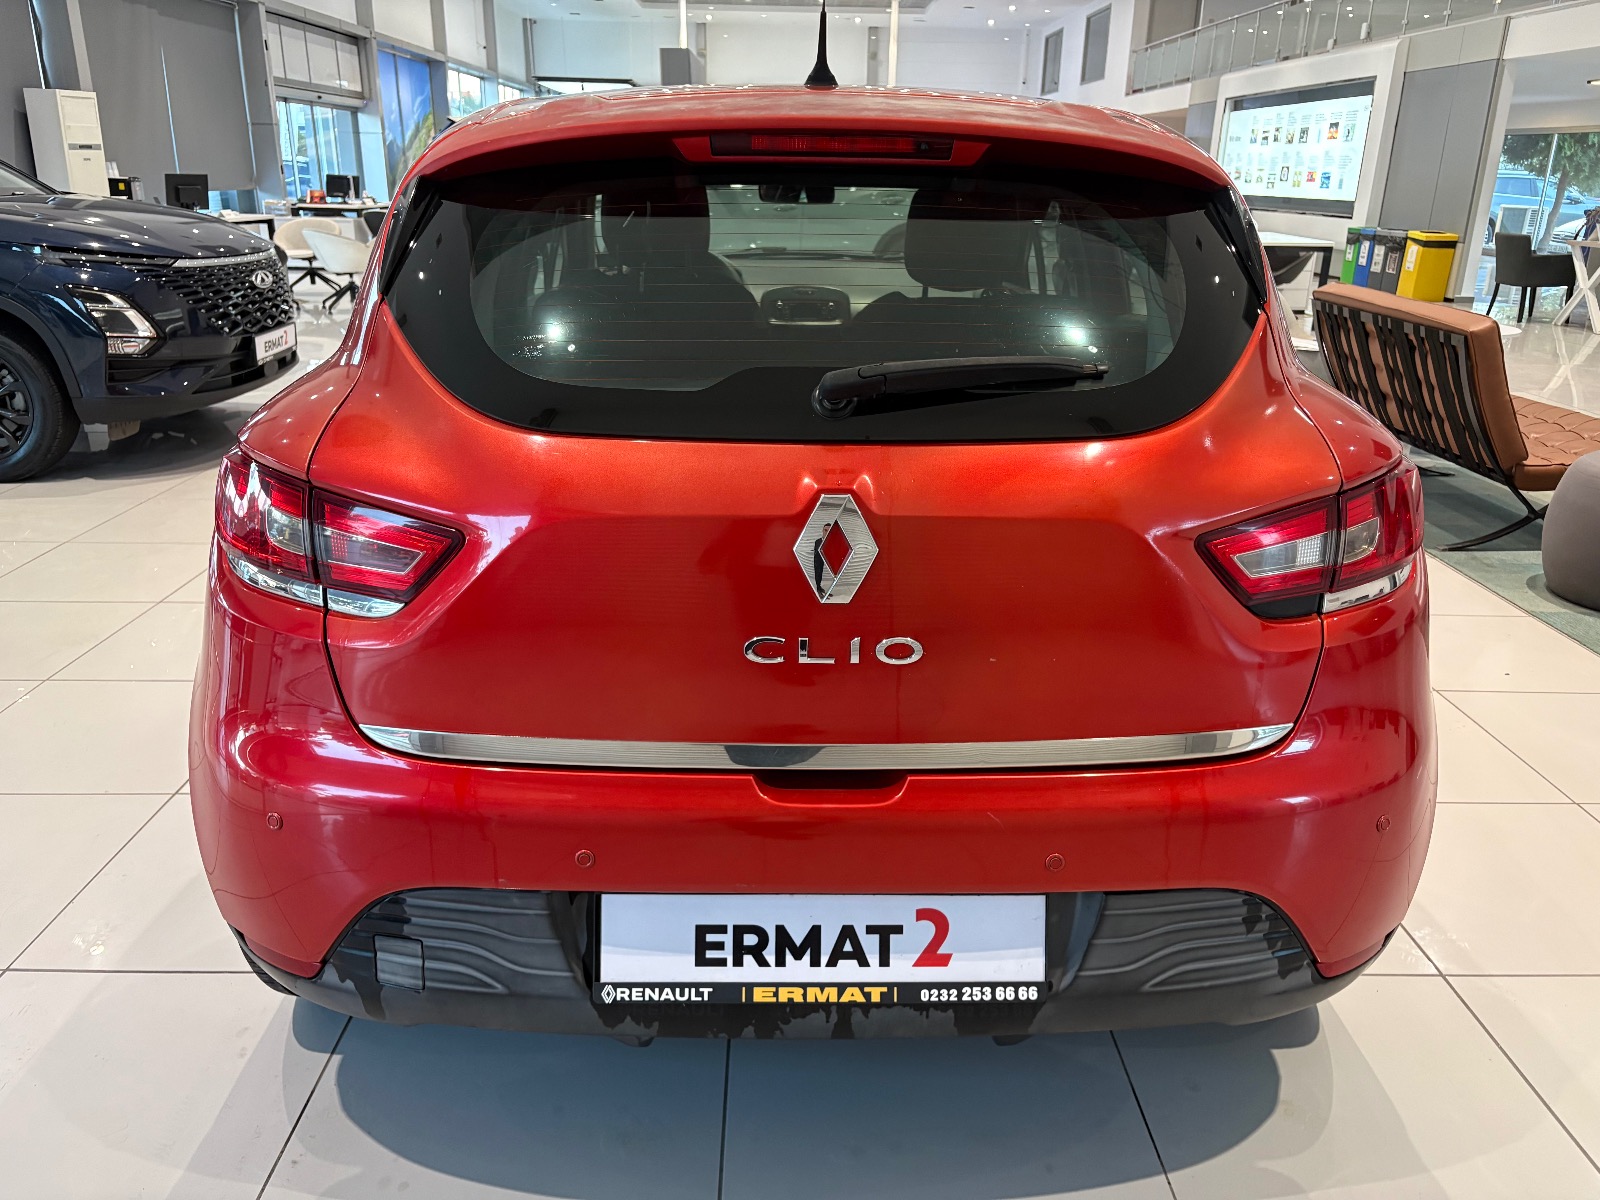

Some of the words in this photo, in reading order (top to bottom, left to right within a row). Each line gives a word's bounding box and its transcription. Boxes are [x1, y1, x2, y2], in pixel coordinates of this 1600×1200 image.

[264, 335, 284, 353] ERMAT
[283, 330, 288, 345] 2
[743, 635, 924, 665] CLIO
[694, 924, 904, 968] ERMAT
[911, 907, 954, 968] 2
[616, 987, 713, 1001] RENAULT
[752, 986, 888, 1003] ERMAT
[920, 988, 958, 1002] 0232
[961, 986, 992, 1001] 253
[995, 986, 1015, 1001] 66
[1018, 986, 1038, 1001] 66
